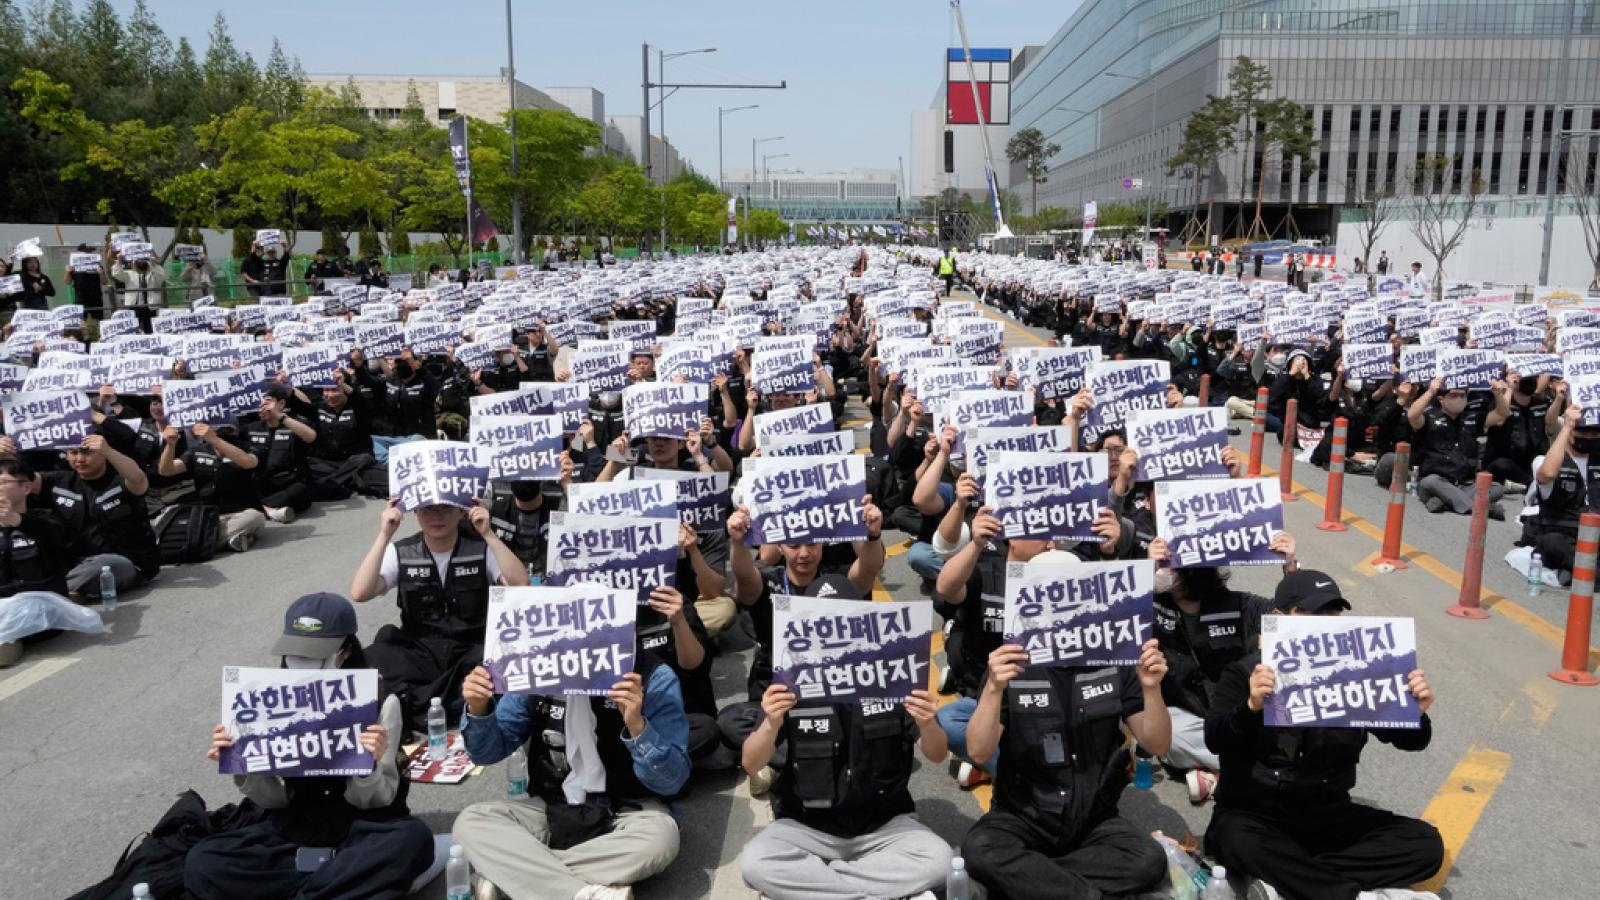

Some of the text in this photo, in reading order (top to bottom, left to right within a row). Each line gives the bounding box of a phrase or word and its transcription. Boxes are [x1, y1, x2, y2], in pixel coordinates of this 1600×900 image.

[102, 320, 133, 336] 상한폐지
[174, 314, 206, 327] 상한폐지
[612, 322, 651, 339] 상한폐지
[788, 321, 825, 335] 상한폐지
[885, 323, 921, 337] 상한폐지
[960, 322, 998, 335] 상한폐지
[1274, 319, 1307, 333] 상한폐지
[1346, 318, 1381, 335] 상한폐지
[1473, 320, 1510, 336] 상한폐지
[327, 327, 355, 340] 상한폐
[359, 325, 398, 343] 상한폐지
[408, 325, 445, 340] 상한폐지
[1479, 335, 1516, 348] 실현하자
[120, 336, 162, 353] 상한폐지
[187, 337, 232, 354] 상한폐지
[364, 341, 403, 358] 실현하자
[460, 343, 490, 359] 상한폐지
[632, 340, 656, 350] 하자
[954, 335, 994, 354] 상한폐지
[1346, 344, 1387, 360] 상한폐지
[113, 359, 164, 374] 상한폐지
[188, 356, 233, 371] 실현하자
[286, 349, 329, 369] 상한폐지
[573, 354, 620, 375] 상한폐지
[660, 349, 704, 373] 상한폐지
[755, 351, 804, 374] 상한폐지
[900, 348, 944, 366] 상한폐지
[1035, 350, 1093, 376] 상한폐지
[1404, 349, 1436, 367] 상한폐
[1440, 350, 1487, 371] 상한폐지
[228, 368, 257, 390] 폐지
[291, 368, 334, 386] 실현하자
[1092, 363, 1160, 394] 상한폐지
[1350, 361, 1392, 378] 실현하자
[1445, 371, 1492, 389] 실현하자
[25, 374, 80, 391] 상한폐지
[115, 377, 161, 393] 실현하자
[760, 372, 814, 394] 실현하자
[922, 371, 978, 391] 상한폐지
[165, 380, 218, 405] 상한폐지
[552, 387, 580, 406] 폐지
[625, 385, 684, 413] 상한폐지
[10, 393, 80, 423] 상한폐지
[169, 402, 230, 427] 실현하자
[956, 396, 1025, 423] 상한폐지
[1100, 391, 1166, 422] 실현하자
[18, 419, 92, 449] 실현하자
[476, 419, 551, 447] 상한폐지
[1135, 410, 1215, 447] 상한폐지
[1144, 443, 1223, 480] 실현하자
[677, 476, 717, 498] 폐지
[751, 460, 849, 503] 상한폐지
[994, 457, 1093, 497] 상한폐지
[578, 483, 663, 514] 상한폐지
[1164, 483, 1264, 527] 상한폐지
[680, 505, 725, 526] 하자
[761, 499, 865, 543] 실현하자
[1002, 499, 1100, 537] 실현하자
[556, 522, 662, 559] 상한폐지
[1178, 522, 1273, 565] 실현하자
[1015, 565, 1136, 617] 상한폐지
[496, 594, 616, 643] 상한폐지
[783, 607, 912, 652] 상한폐지
[1026, 614, 1152, 664] 실현하자
[1209, 626, 1236, 637] SELU
[642, 636, 668, 650] SELU
[1272, 622, 1395, 673] 상한폐지
[503, 644, 633, 691] 실현하자
[795, 654, 928, 698] 실현하자
[231, 673, 356, 725] 상한폐지
[1018, 693, 1050, 708] 투쟁
[1081, 682, 1114, 700] SELU
[1286, 673, 1409, 724] 실현하자
[863, 701, 895, 716] SELU
[242, 722, 366, 773] 실현하자
